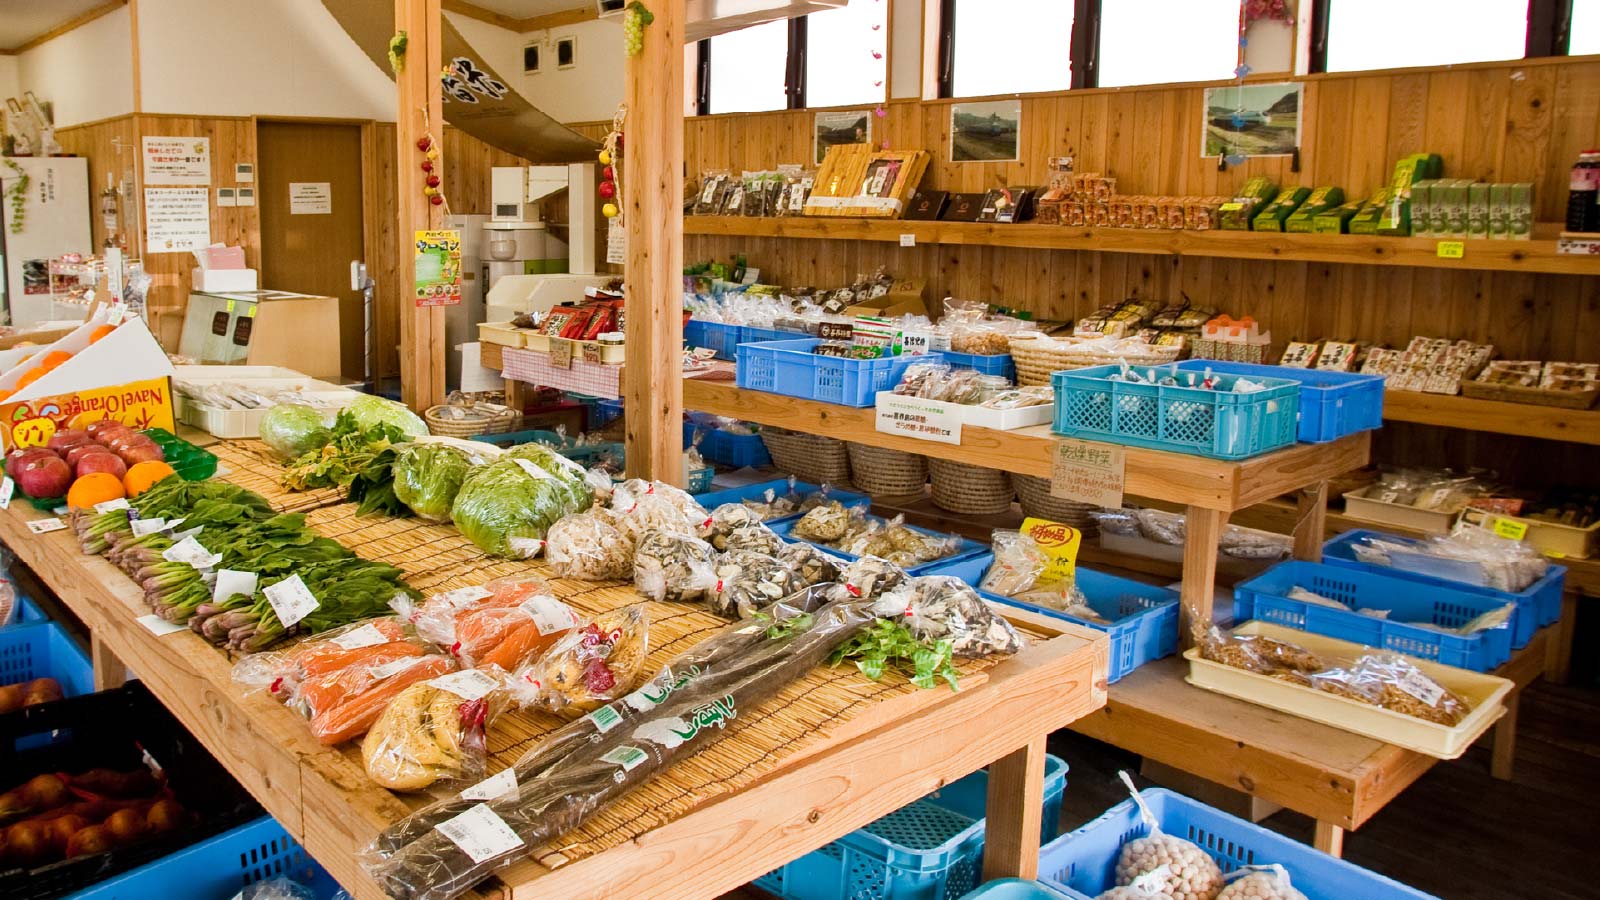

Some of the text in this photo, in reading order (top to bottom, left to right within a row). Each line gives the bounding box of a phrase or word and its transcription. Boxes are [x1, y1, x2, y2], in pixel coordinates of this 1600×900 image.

[416, 240, 458, 253] ヤーコン
[63, 387, 163, 416] Navel Orange
[669, 694, 737, 741] ごぼう
